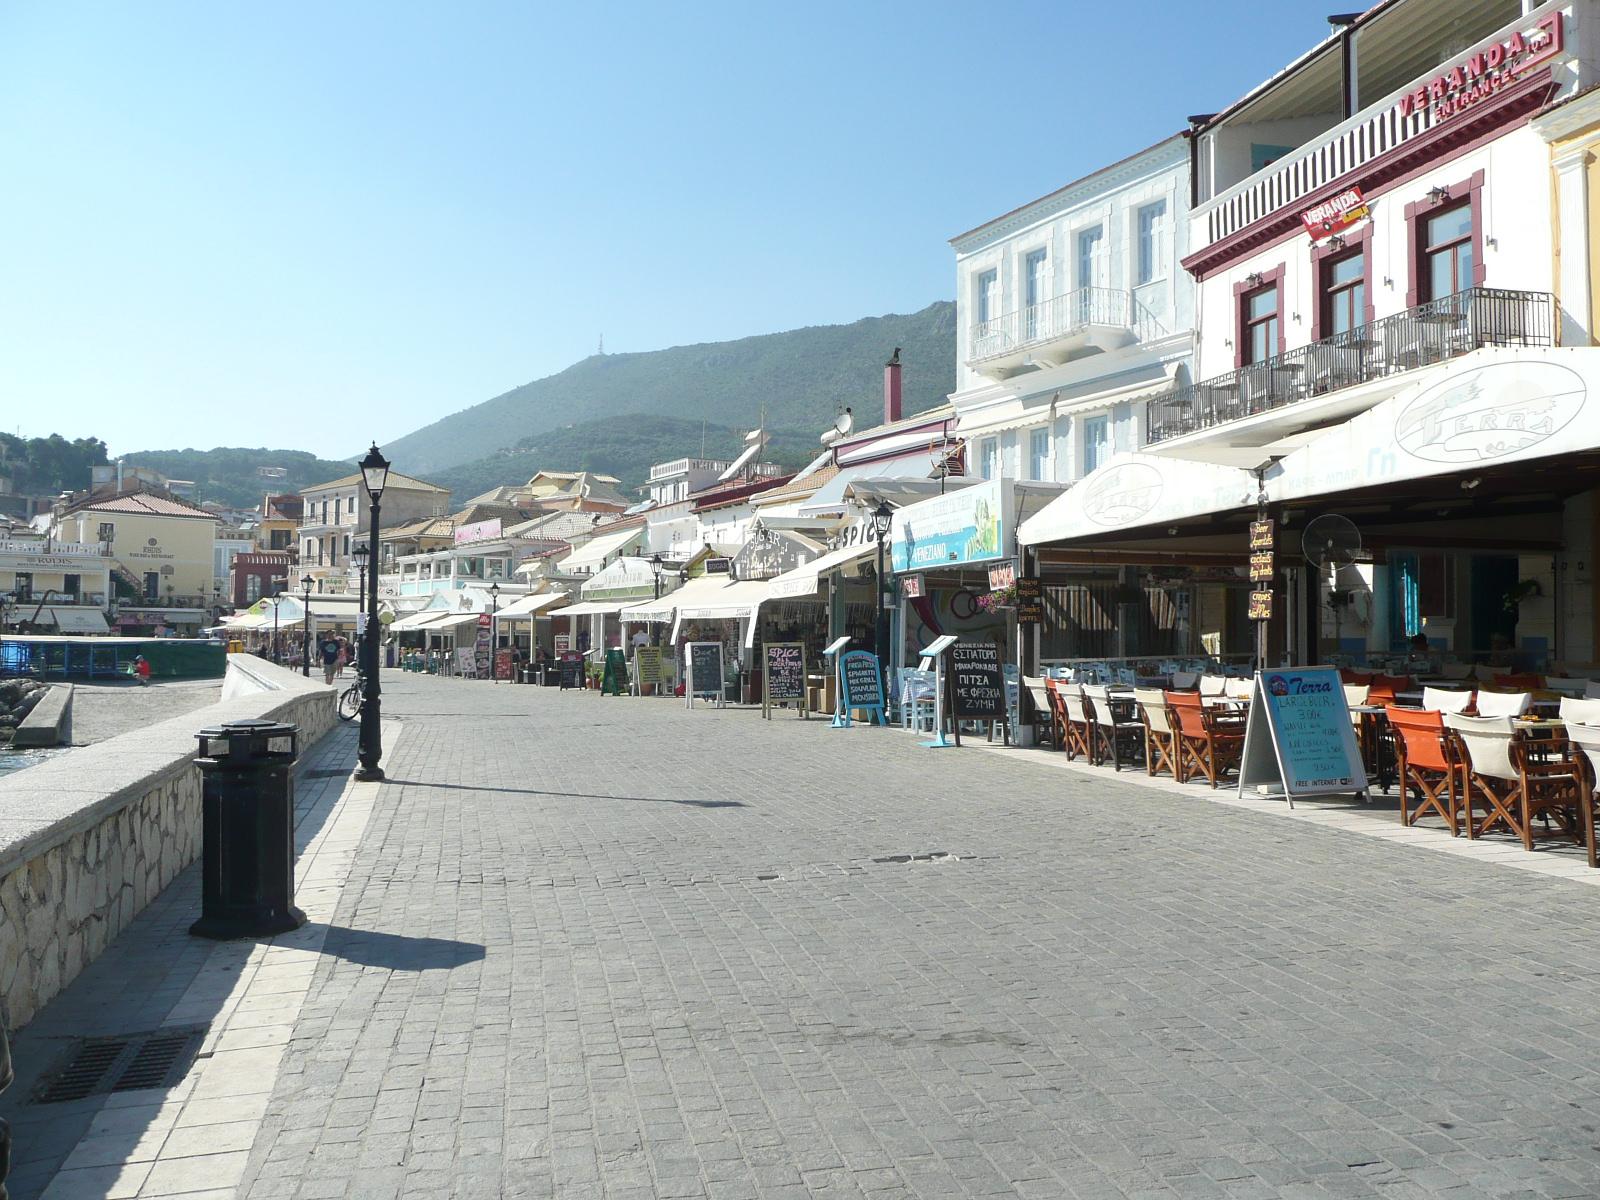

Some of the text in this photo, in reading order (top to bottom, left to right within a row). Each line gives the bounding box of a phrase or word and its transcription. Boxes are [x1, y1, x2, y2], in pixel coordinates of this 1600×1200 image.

[1399, 32, 1526, 117] VERANDA
[1435, 69, 1517, 121] ENTRANCE
[1303, 190, 1361, 226] VERANDA
[1421, 405, 1555, 446] TERRA
[1256, 523, 1268, 533] Beer
[750, 529, 780, 550] SUGAR
[914, 543, 946, 563] VENEZIANO
[707, 562, 729, 571] SUGAR
[768, 648, 799, 657] SPICE
[960, 674, 989, 685] ΠΙΤΣΑ
[1289, 677, 1332, 695] Terra
[966, 700, 995, 710] ΖΥΜΗ
